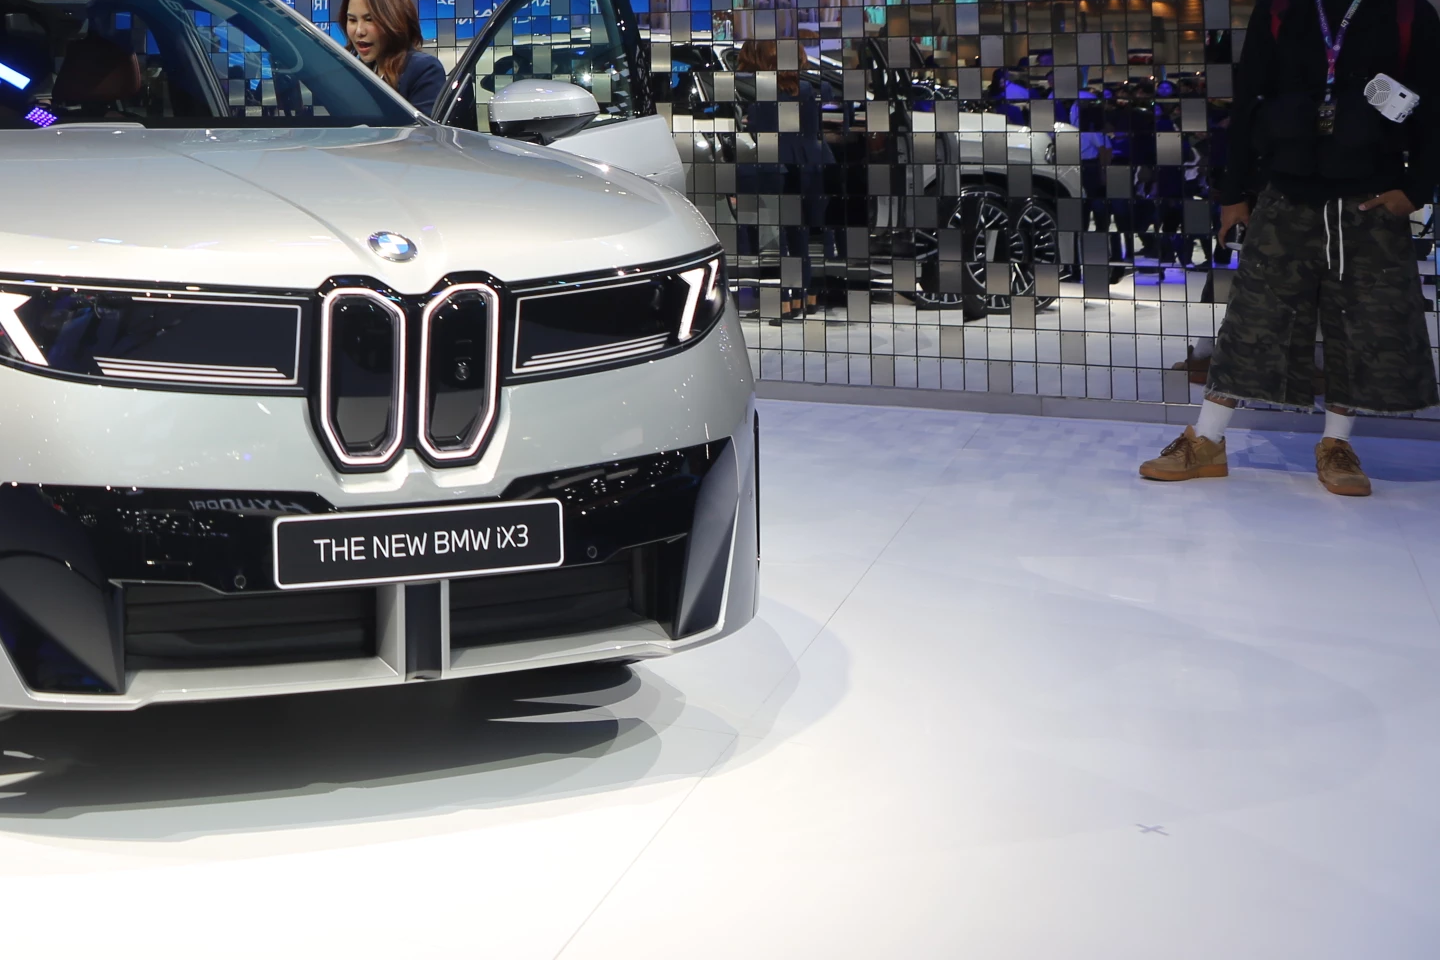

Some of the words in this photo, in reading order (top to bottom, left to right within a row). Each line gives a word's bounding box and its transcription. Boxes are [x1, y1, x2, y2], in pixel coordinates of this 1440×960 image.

[313, 536, 366, 562] THE
[373, 532, 427, 558] NEW
[434, 527, 491, 554] BMW
[496, 524, 529, 549] iX3
